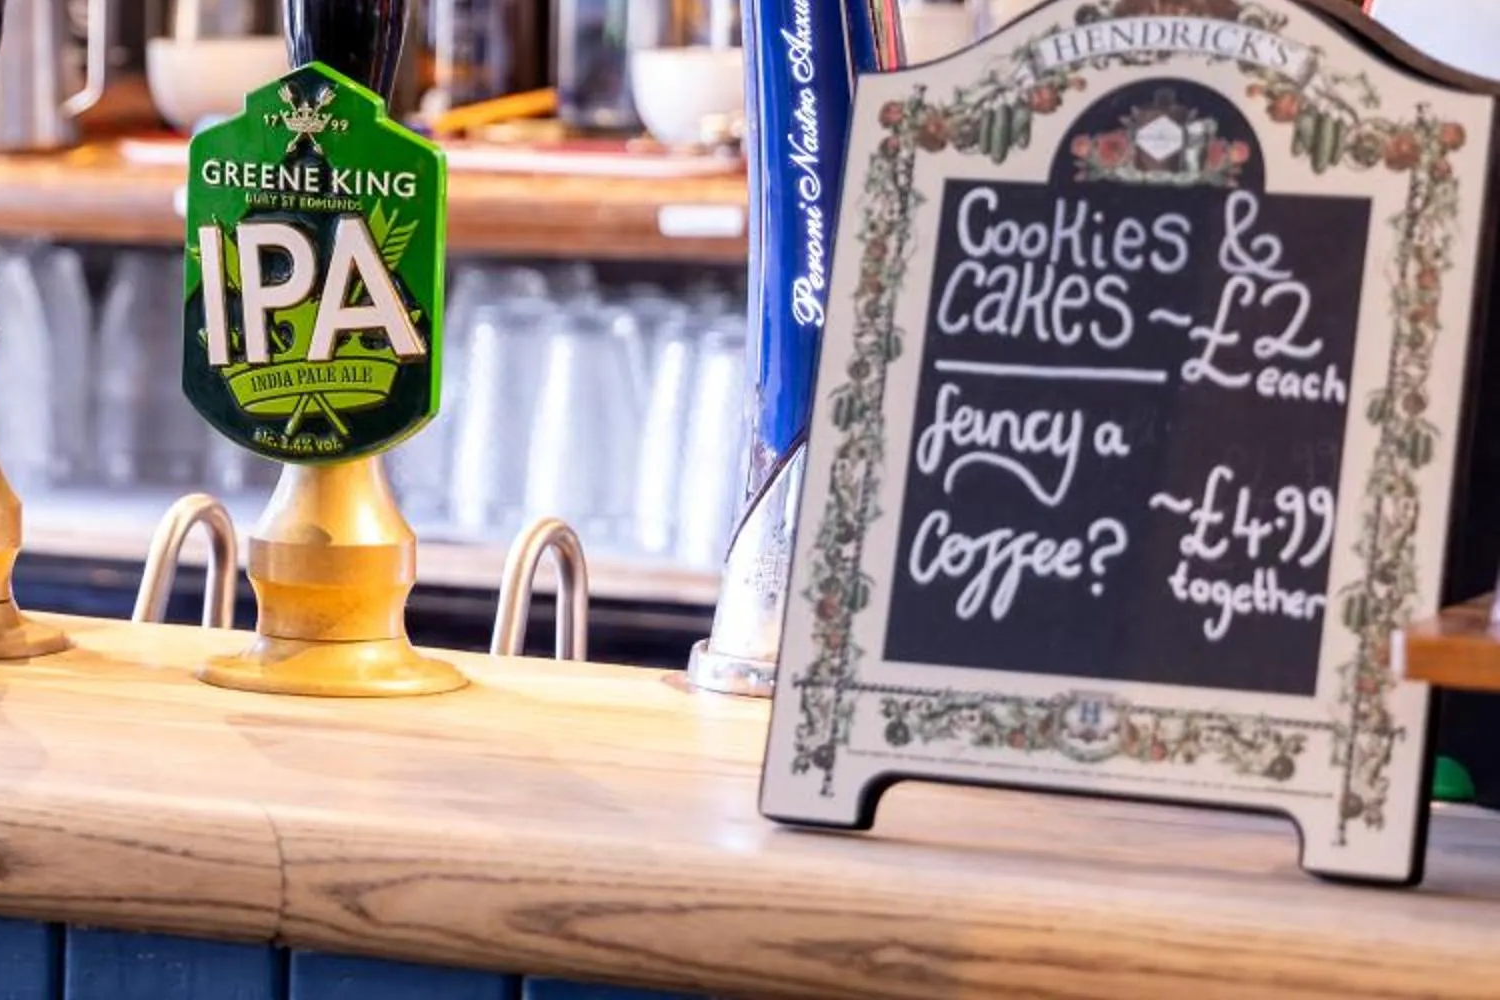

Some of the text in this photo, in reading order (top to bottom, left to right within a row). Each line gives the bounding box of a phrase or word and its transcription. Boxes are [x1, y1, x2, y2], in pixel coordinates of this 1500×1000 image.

[1053, 21, 1290, 67] HENDRICK'S
[787, 87, 821, 202] Nastro
[202, 160, 418, 198] GREENE KING
[300, 196, 363, 211] EDMUNDS
[792, 202, 825, 328] Peroni
[1217, 189, 1293, 280] &
[198, 216, 429, 366] IPA
[251, 365, 373, 393] INDIA PALE ALE
[1256, 364, 1346, 405] each
[1093, 421, 1130, 456] a
[909, 509, 1129, 621] Coffee?
[1168, 561, 1328, 642] together
